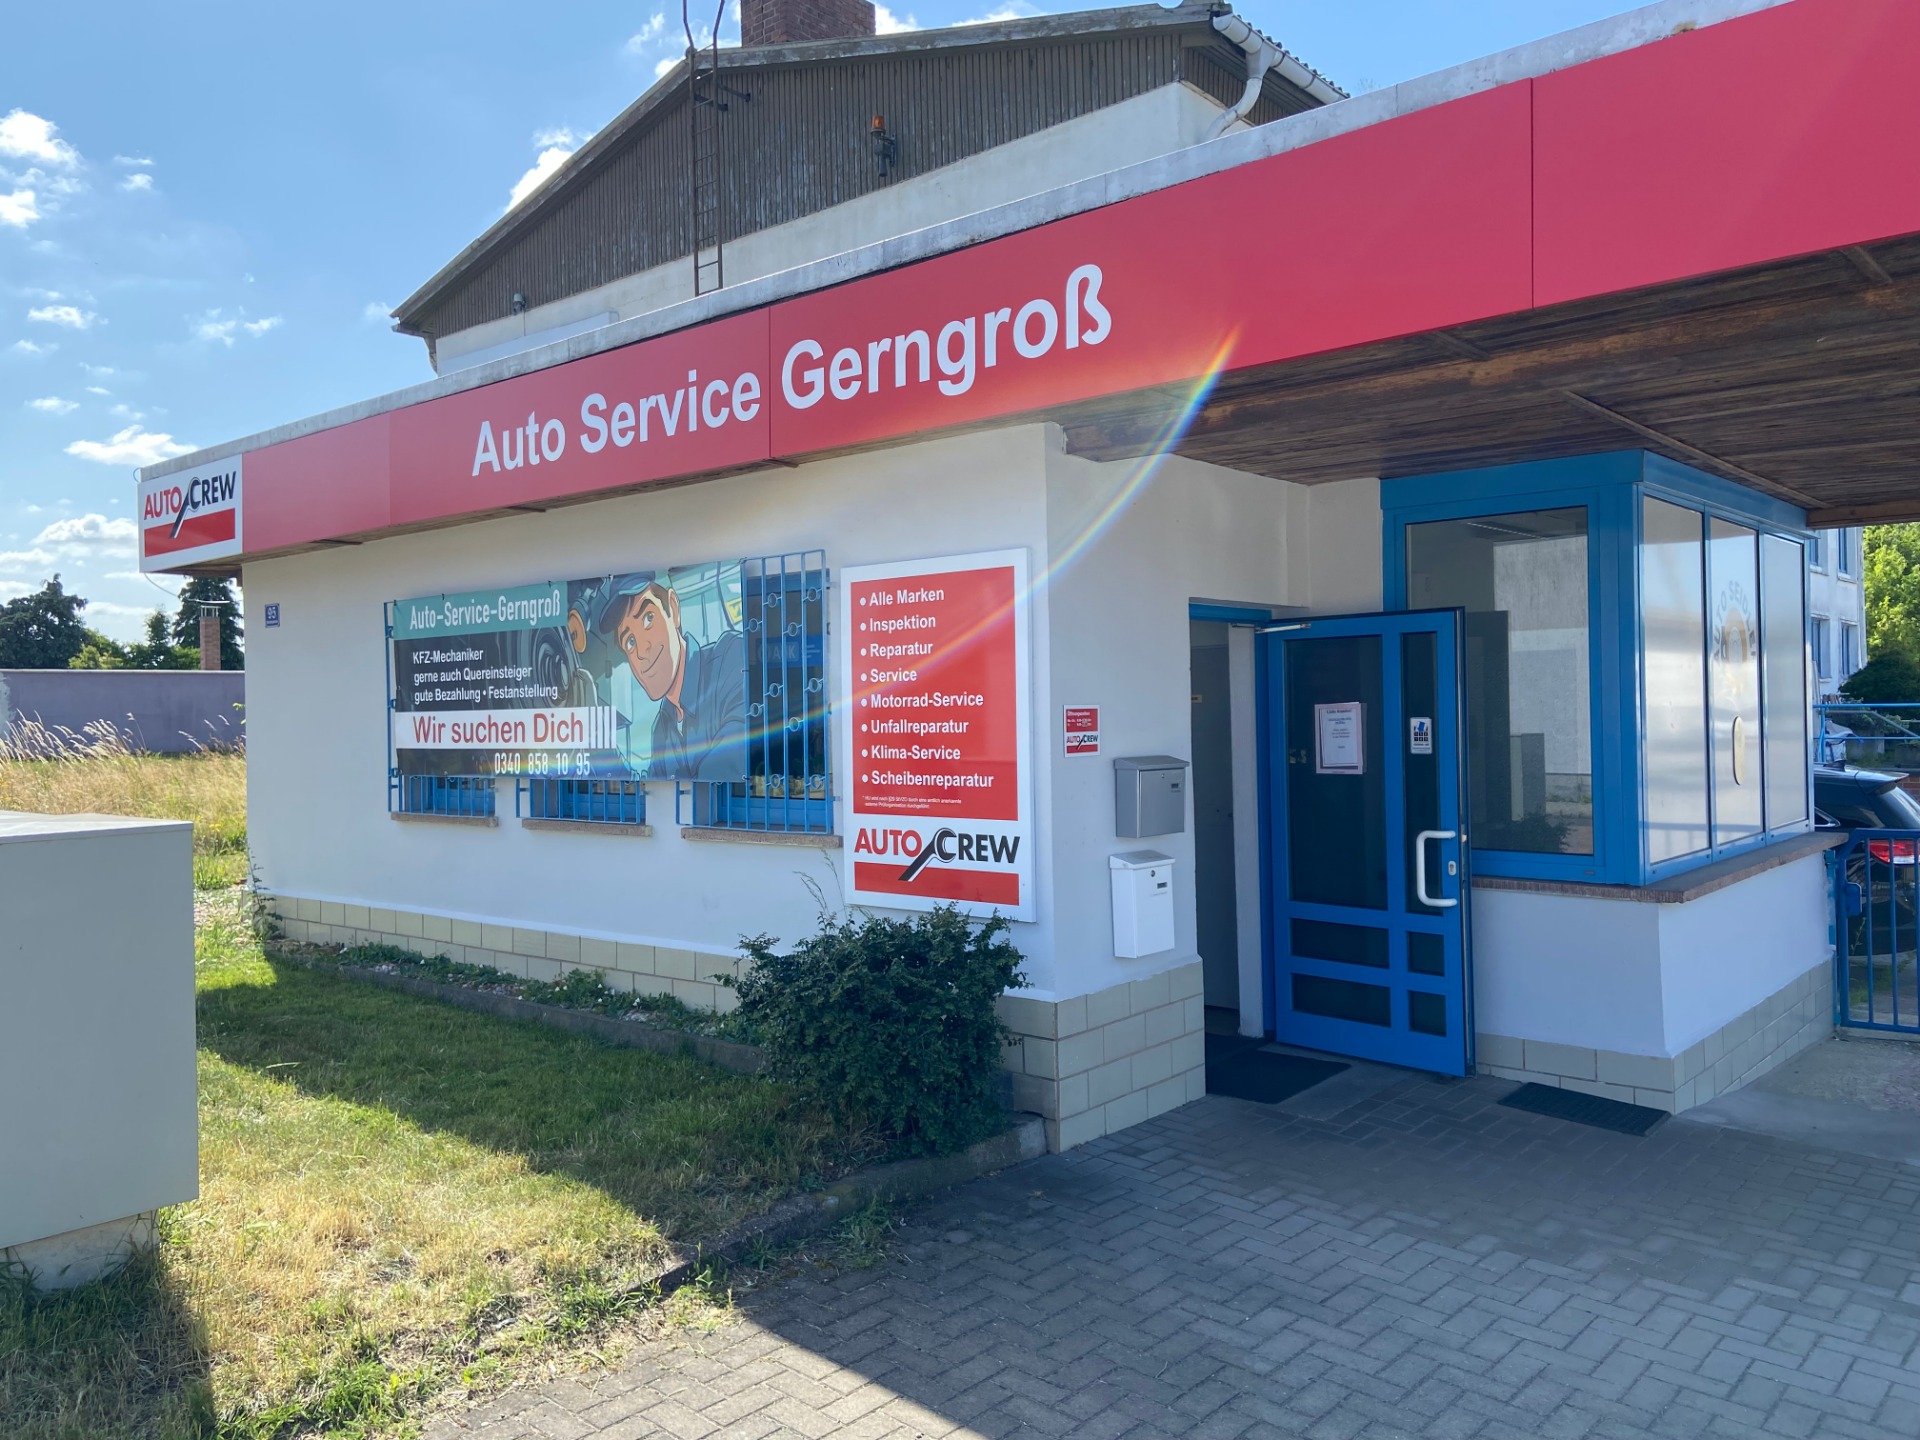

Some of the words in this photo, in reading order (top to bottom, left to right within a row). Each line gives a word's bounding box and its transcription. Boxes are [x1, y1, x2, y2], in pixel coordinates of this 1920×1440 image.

[471, 410, 566, 477] Auto
[580, 369, 762, 455] Service
[781, 263, 1112, 410] Gerngroß
[144, 486, 182, 520] AUTO
[189, 471, 237, 510] CREW
[869, 592, 893, 606] Alle
[897, 588, 945, 604] Marken
[409, 588, 561, 630] Auto-Service-Gerngroß
[869, 615, 936, 633] Inspektion
[412, 648, 484, 664] KFZ-Mechaniker
[870, 641, 933, 659] Reparatur
[414, 672, 438, 686] gerne
[440, 669, 461, 682] auch
[463, 665, 533, 682] Quereinsteiger
[870, 668, 917, 683] Service
[414, 690, 433, 705] gute
[435, 688, 481, 702] Bezahlung
[488, 685, 558, 700] Festanstellung
[871, 692, 984, 708] Motorrad-Service
[413, 715, 446, 743] Wir
[451, 714, 526, 743] suchen
[533, 712, 583, 743] Dich
[871, 719, 969, 736] Unfallreparatur
[871, 745, 961, 760] Klima-Service
[494, 752, 521, 775] 0340
[528, 752, 548, 775] 858
[556, 752, 568, 775] 10
[576, 752, 591, 775] 95
[871, 770, 994, 790] Scheibenreparatur
[854, 827, 923, 858] AUTO
[936, 830, 1021, 864] CREW
